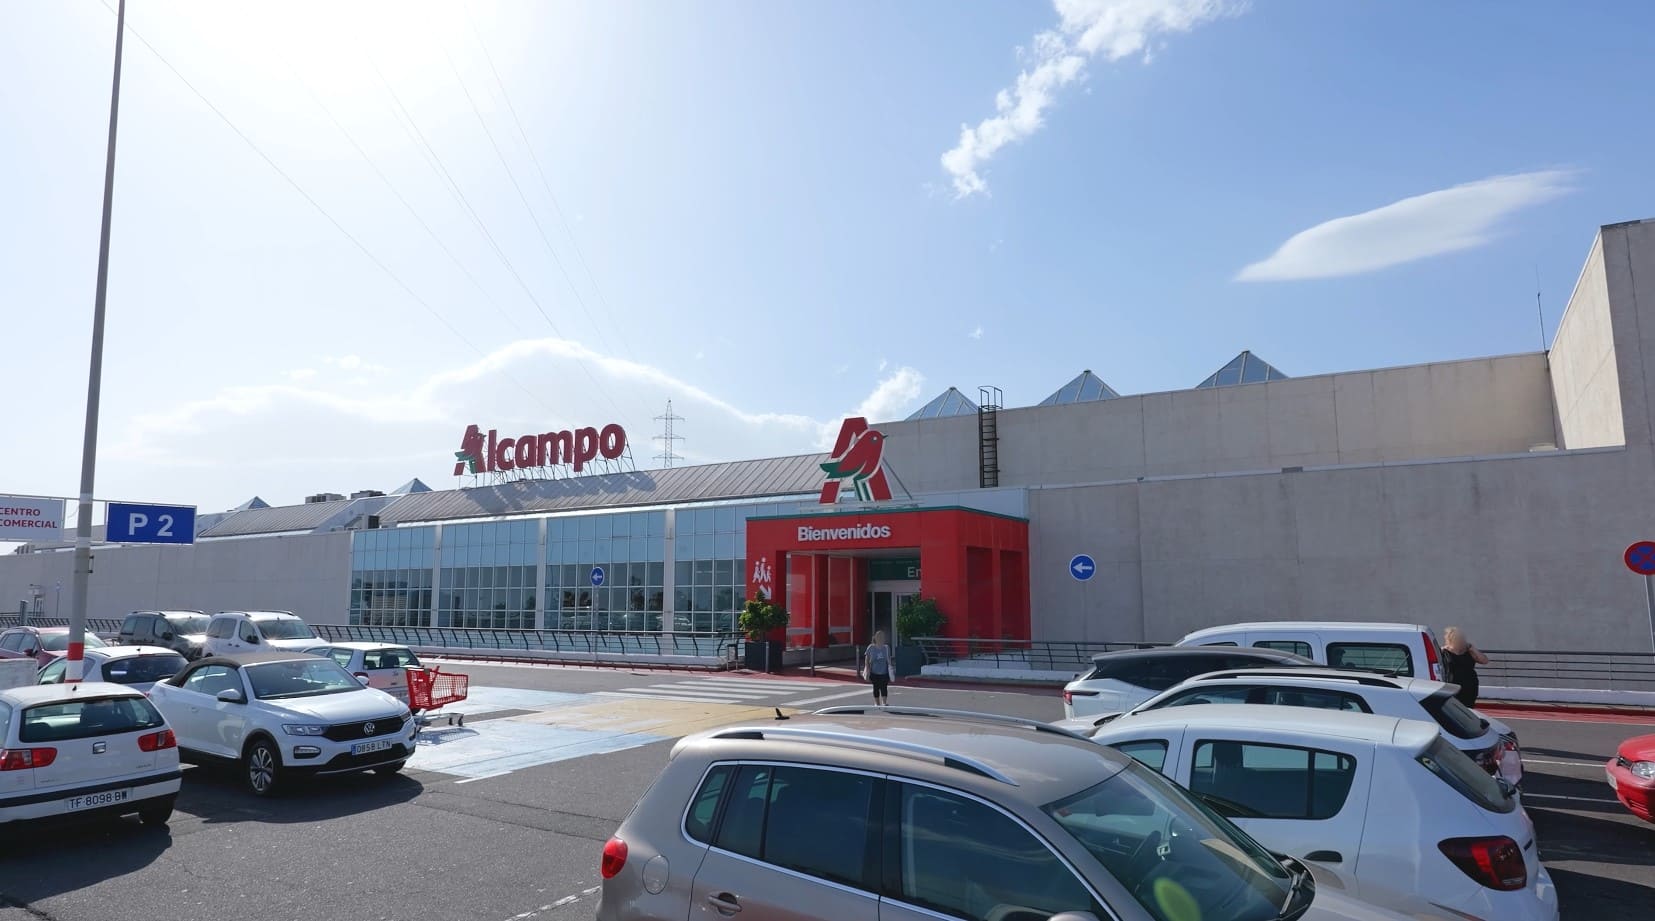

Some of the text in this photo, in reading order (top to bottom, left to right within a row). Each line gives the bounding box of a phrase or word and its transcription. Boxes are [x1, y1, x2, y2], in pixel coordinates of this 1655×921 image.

[454, 423, 626, 476] Alcampo
[128, 512, 174, 537] P 2
[797, 522, 892, 542] Bienvenidos
